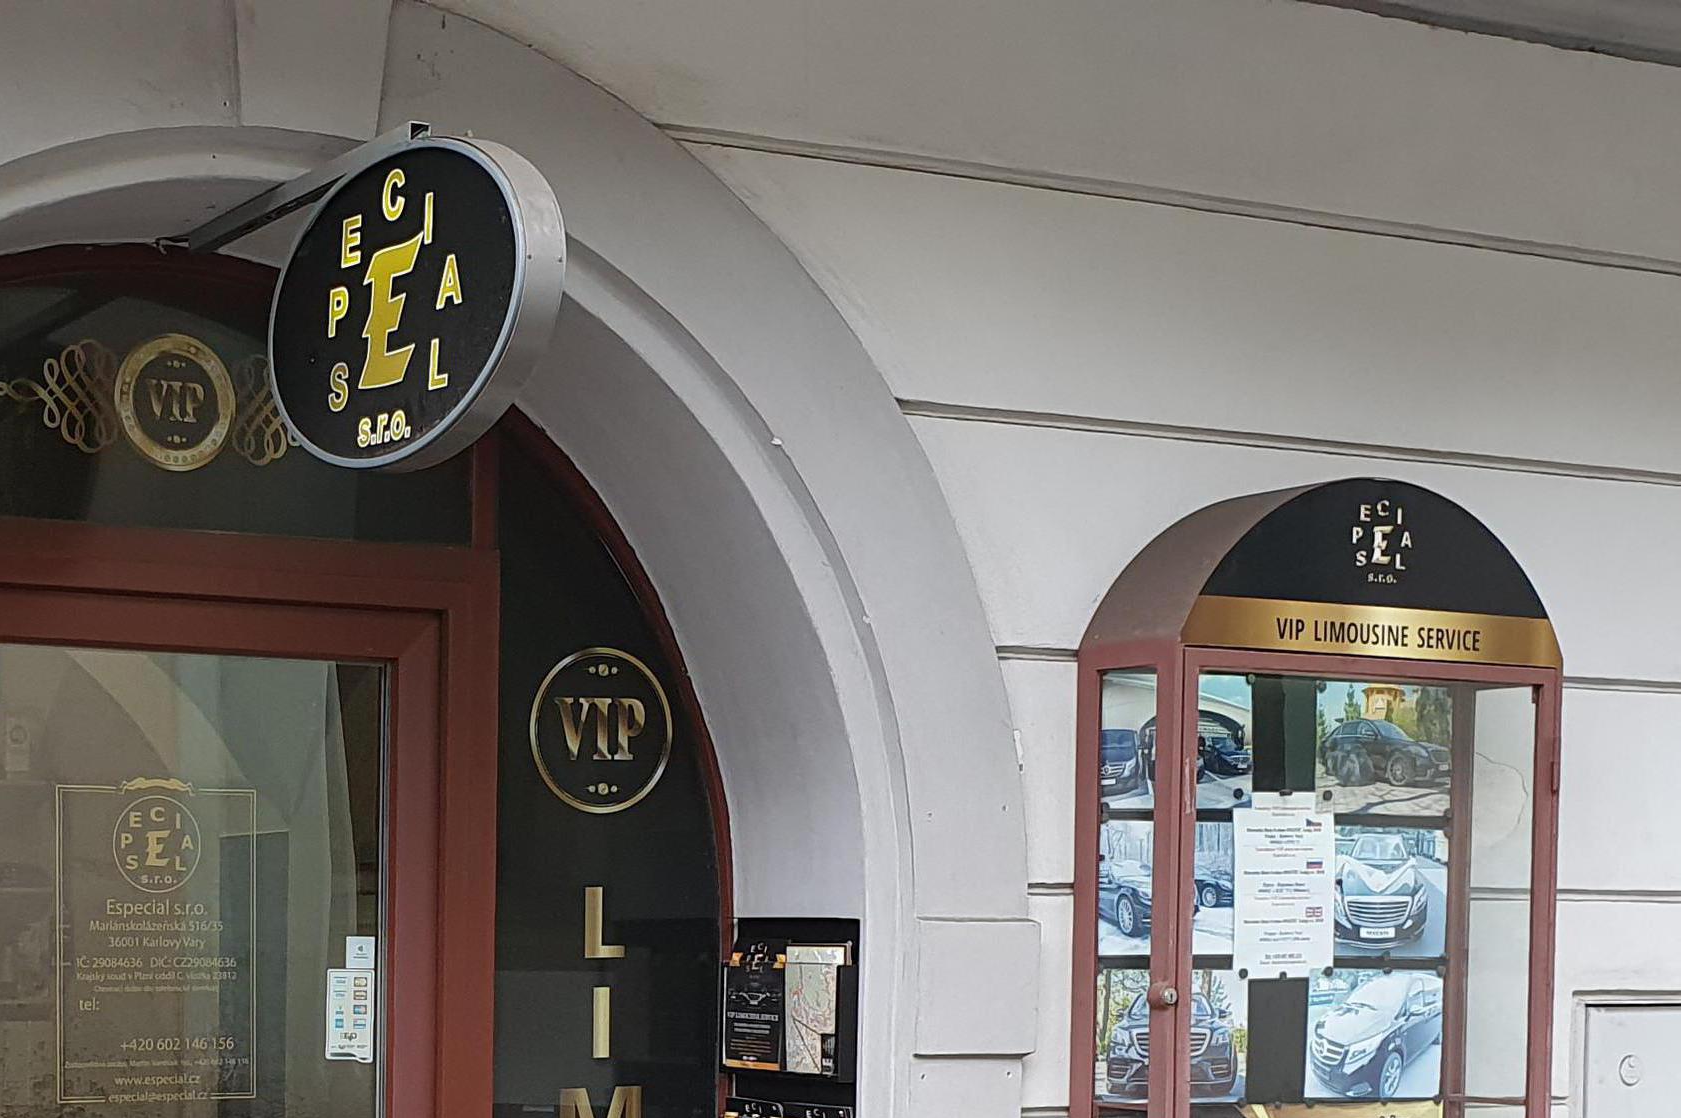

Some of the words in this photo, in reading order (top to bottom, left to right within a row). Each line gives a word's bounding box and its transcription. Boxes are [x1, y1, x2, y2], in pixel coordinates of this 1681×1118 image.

[144, 378, 207, 424] VIP
[357, 410, 411, 448] s.r.o.
[1276, 617, 1305, 642] VIP
[1314, 622, 1409, 649] LIMOUSINE
[1417, 626, 1481, 652] SERVICE
[554, 697, 645, 761] VIP
[140, 874, 178, 885] s.r.o.
[106, 899, 169, 918] Especial
[174, 902, 208, 915] s.r.o.
[108, 937, 139, 948] 36001
[143, 936, 181, 950] Karlovy
[183, 936, 206, 950] Vary
[79, 997, 100, 1010] tel:
[120, 1038, 154, 1051] +420
[157, 1038, 181, 1050] 602
[185, 1037, 208, 1049] 146
[212, 1036, 234, 1049] 156
[114, 1073, 201, 1088] www.especial.cz
